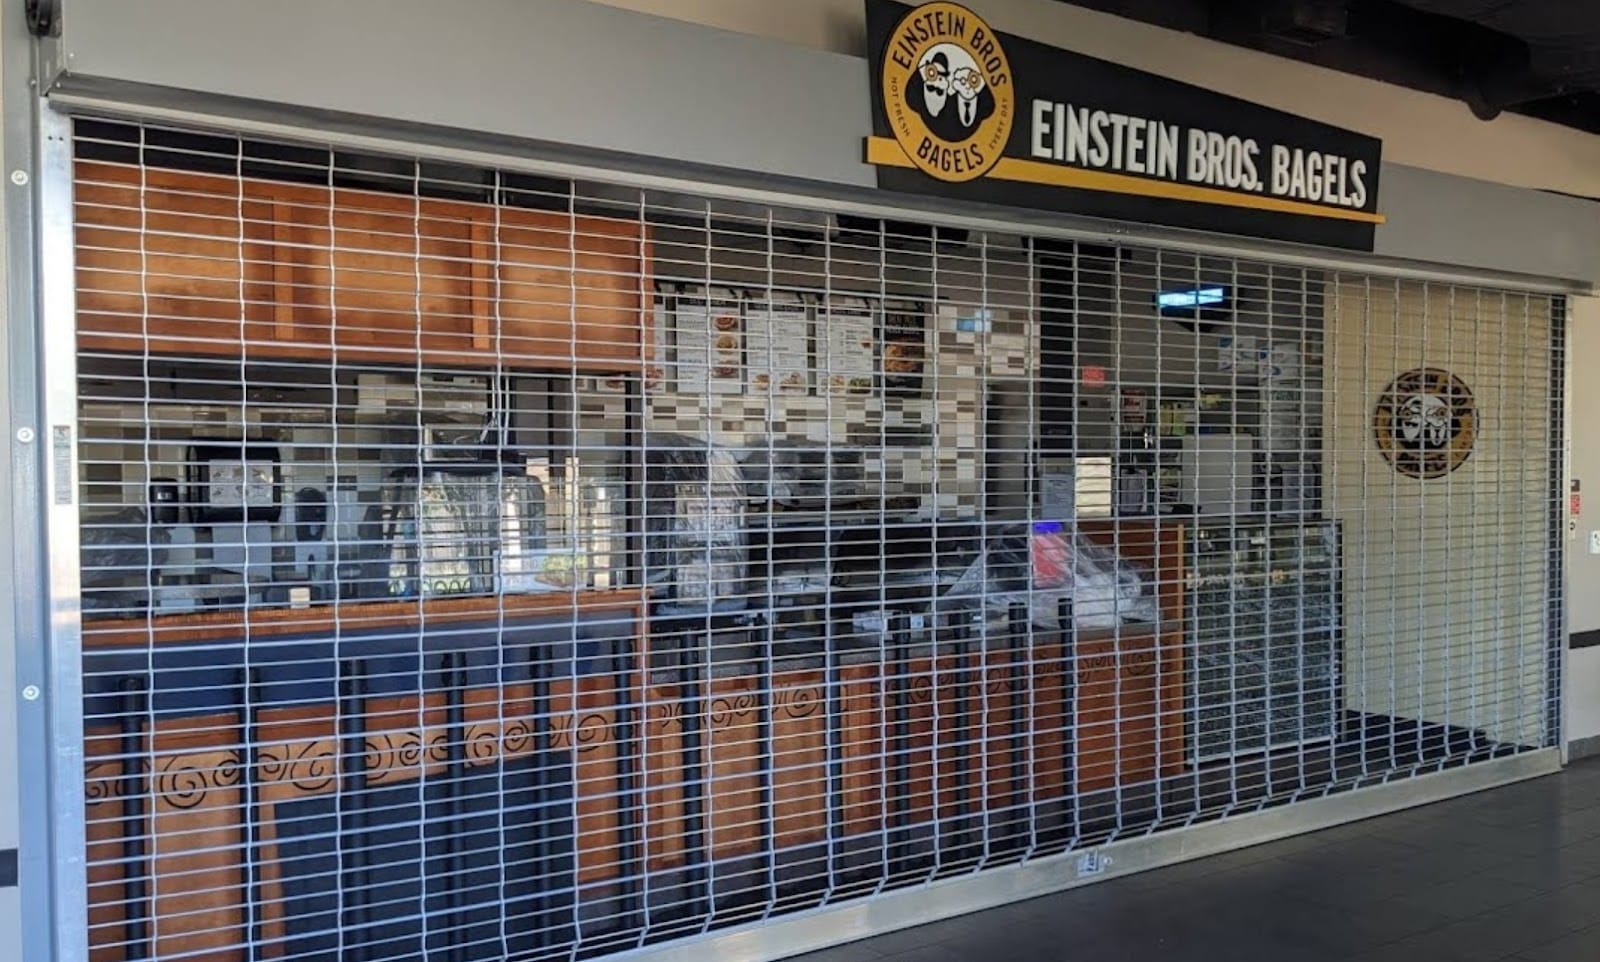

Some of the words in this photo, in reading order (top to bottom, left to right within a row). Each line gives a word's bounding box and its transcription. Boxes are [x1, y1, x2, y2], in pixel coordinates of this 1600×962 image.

[892, 11, 966, 70] EINSTEIN
[970, 27, 1007, 87] BROS
[894, 103, 911, 137] FRESH
[916, 136, 984, 173] BAGELS
[1031, 98, 1179, 181] EINSTEIN
[1186, 128, 1263, 192] BROS.
[1270, 144, 1367, 209] BAGELS
